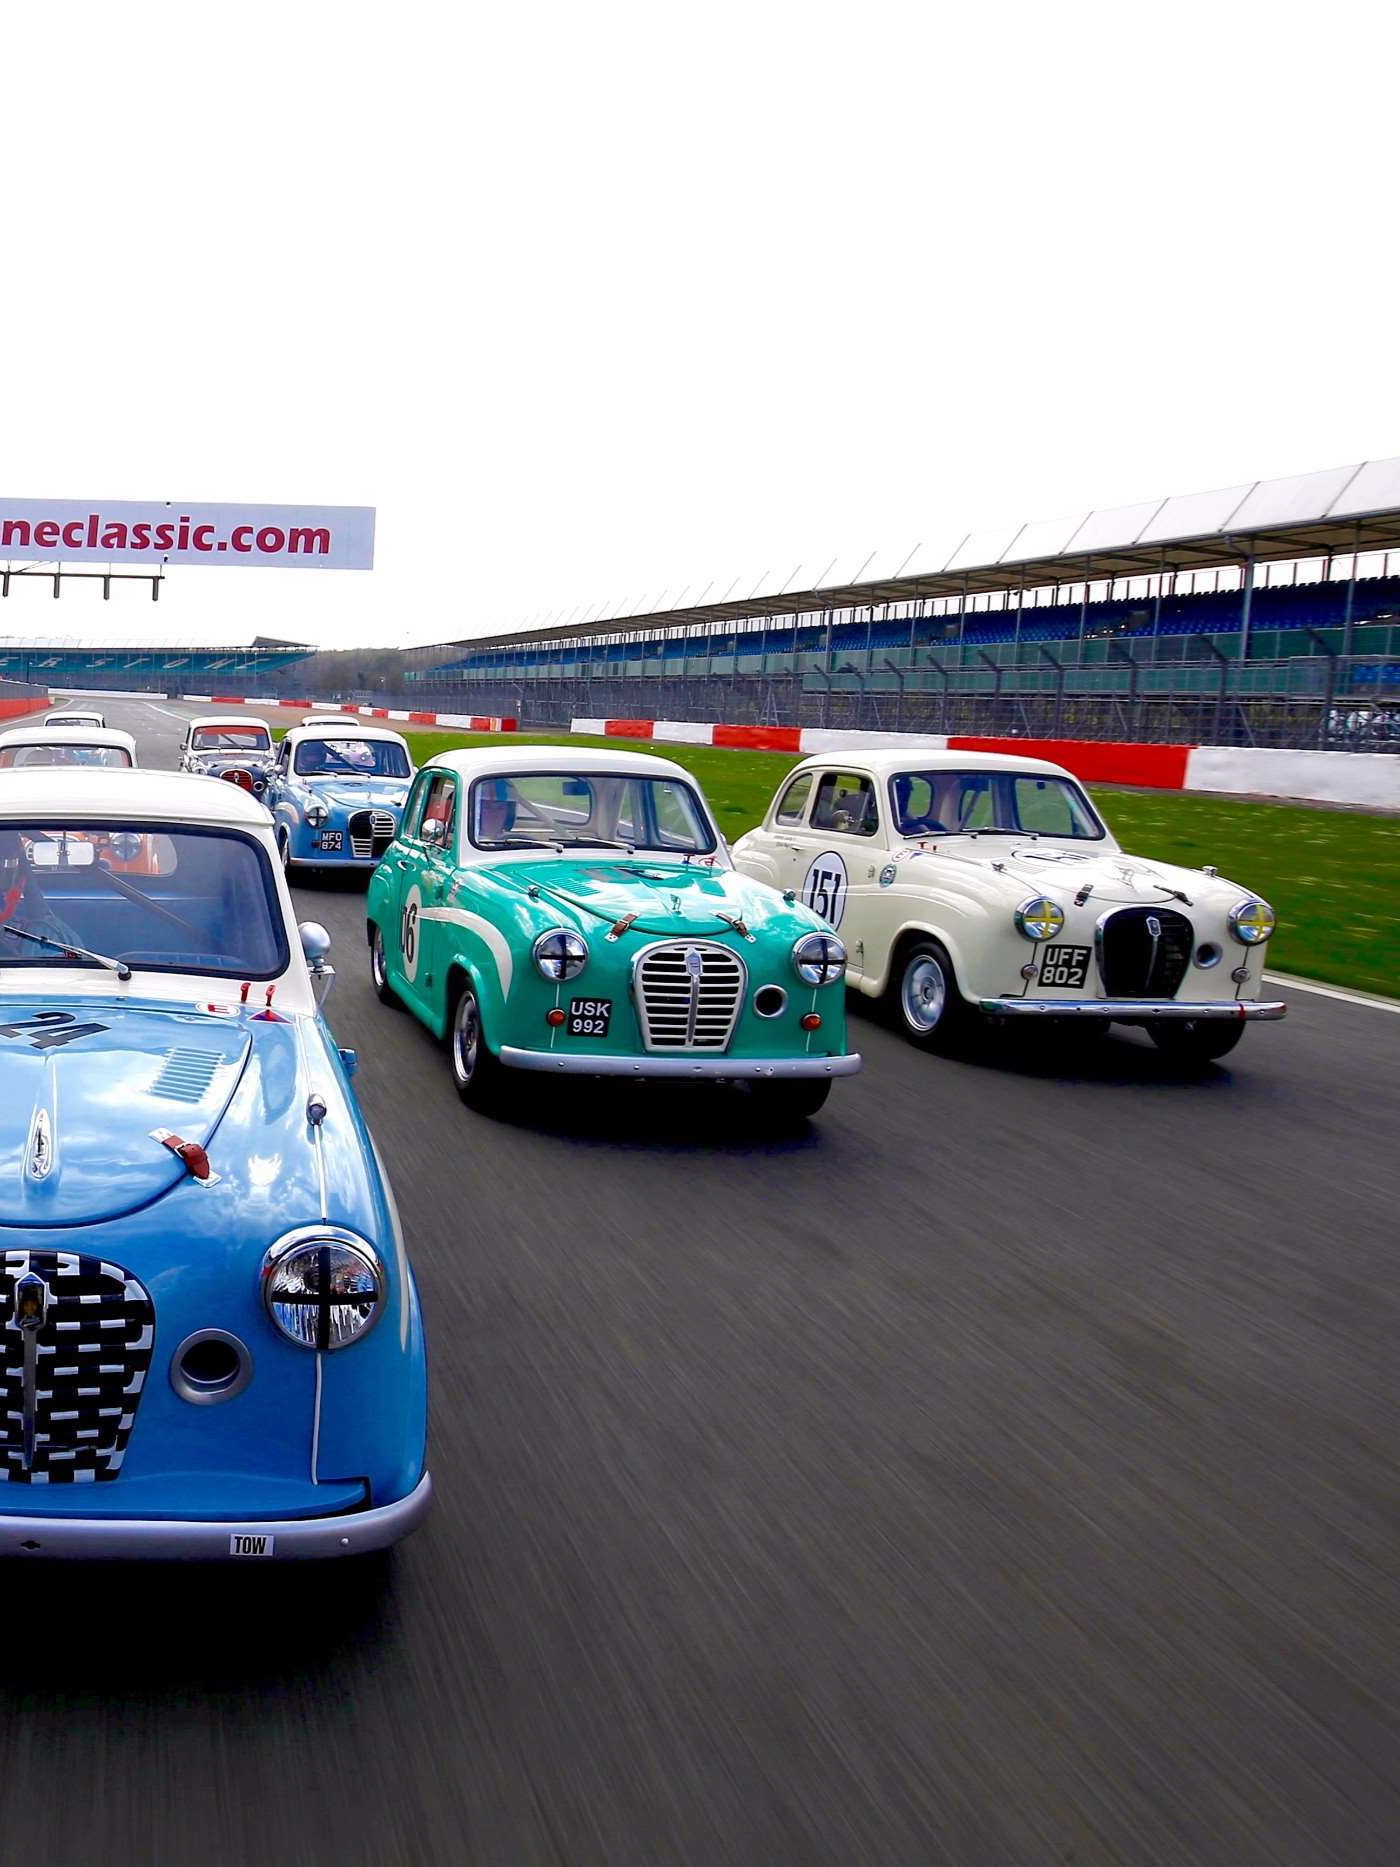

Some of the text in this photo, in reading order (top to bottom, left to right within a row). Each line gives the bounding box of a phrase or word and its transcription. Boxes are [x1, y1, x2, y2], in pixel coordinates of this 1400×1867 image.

[809, 868, 842, 924] 151
[1046, 948, 1087, 966] UFF
[1042, 966, 1083, 985] 802
[571, 1001, 611, 1017] USK
[572, 1018, 605, 1034] 992
[234, 1536, 267, 1555] TOW
